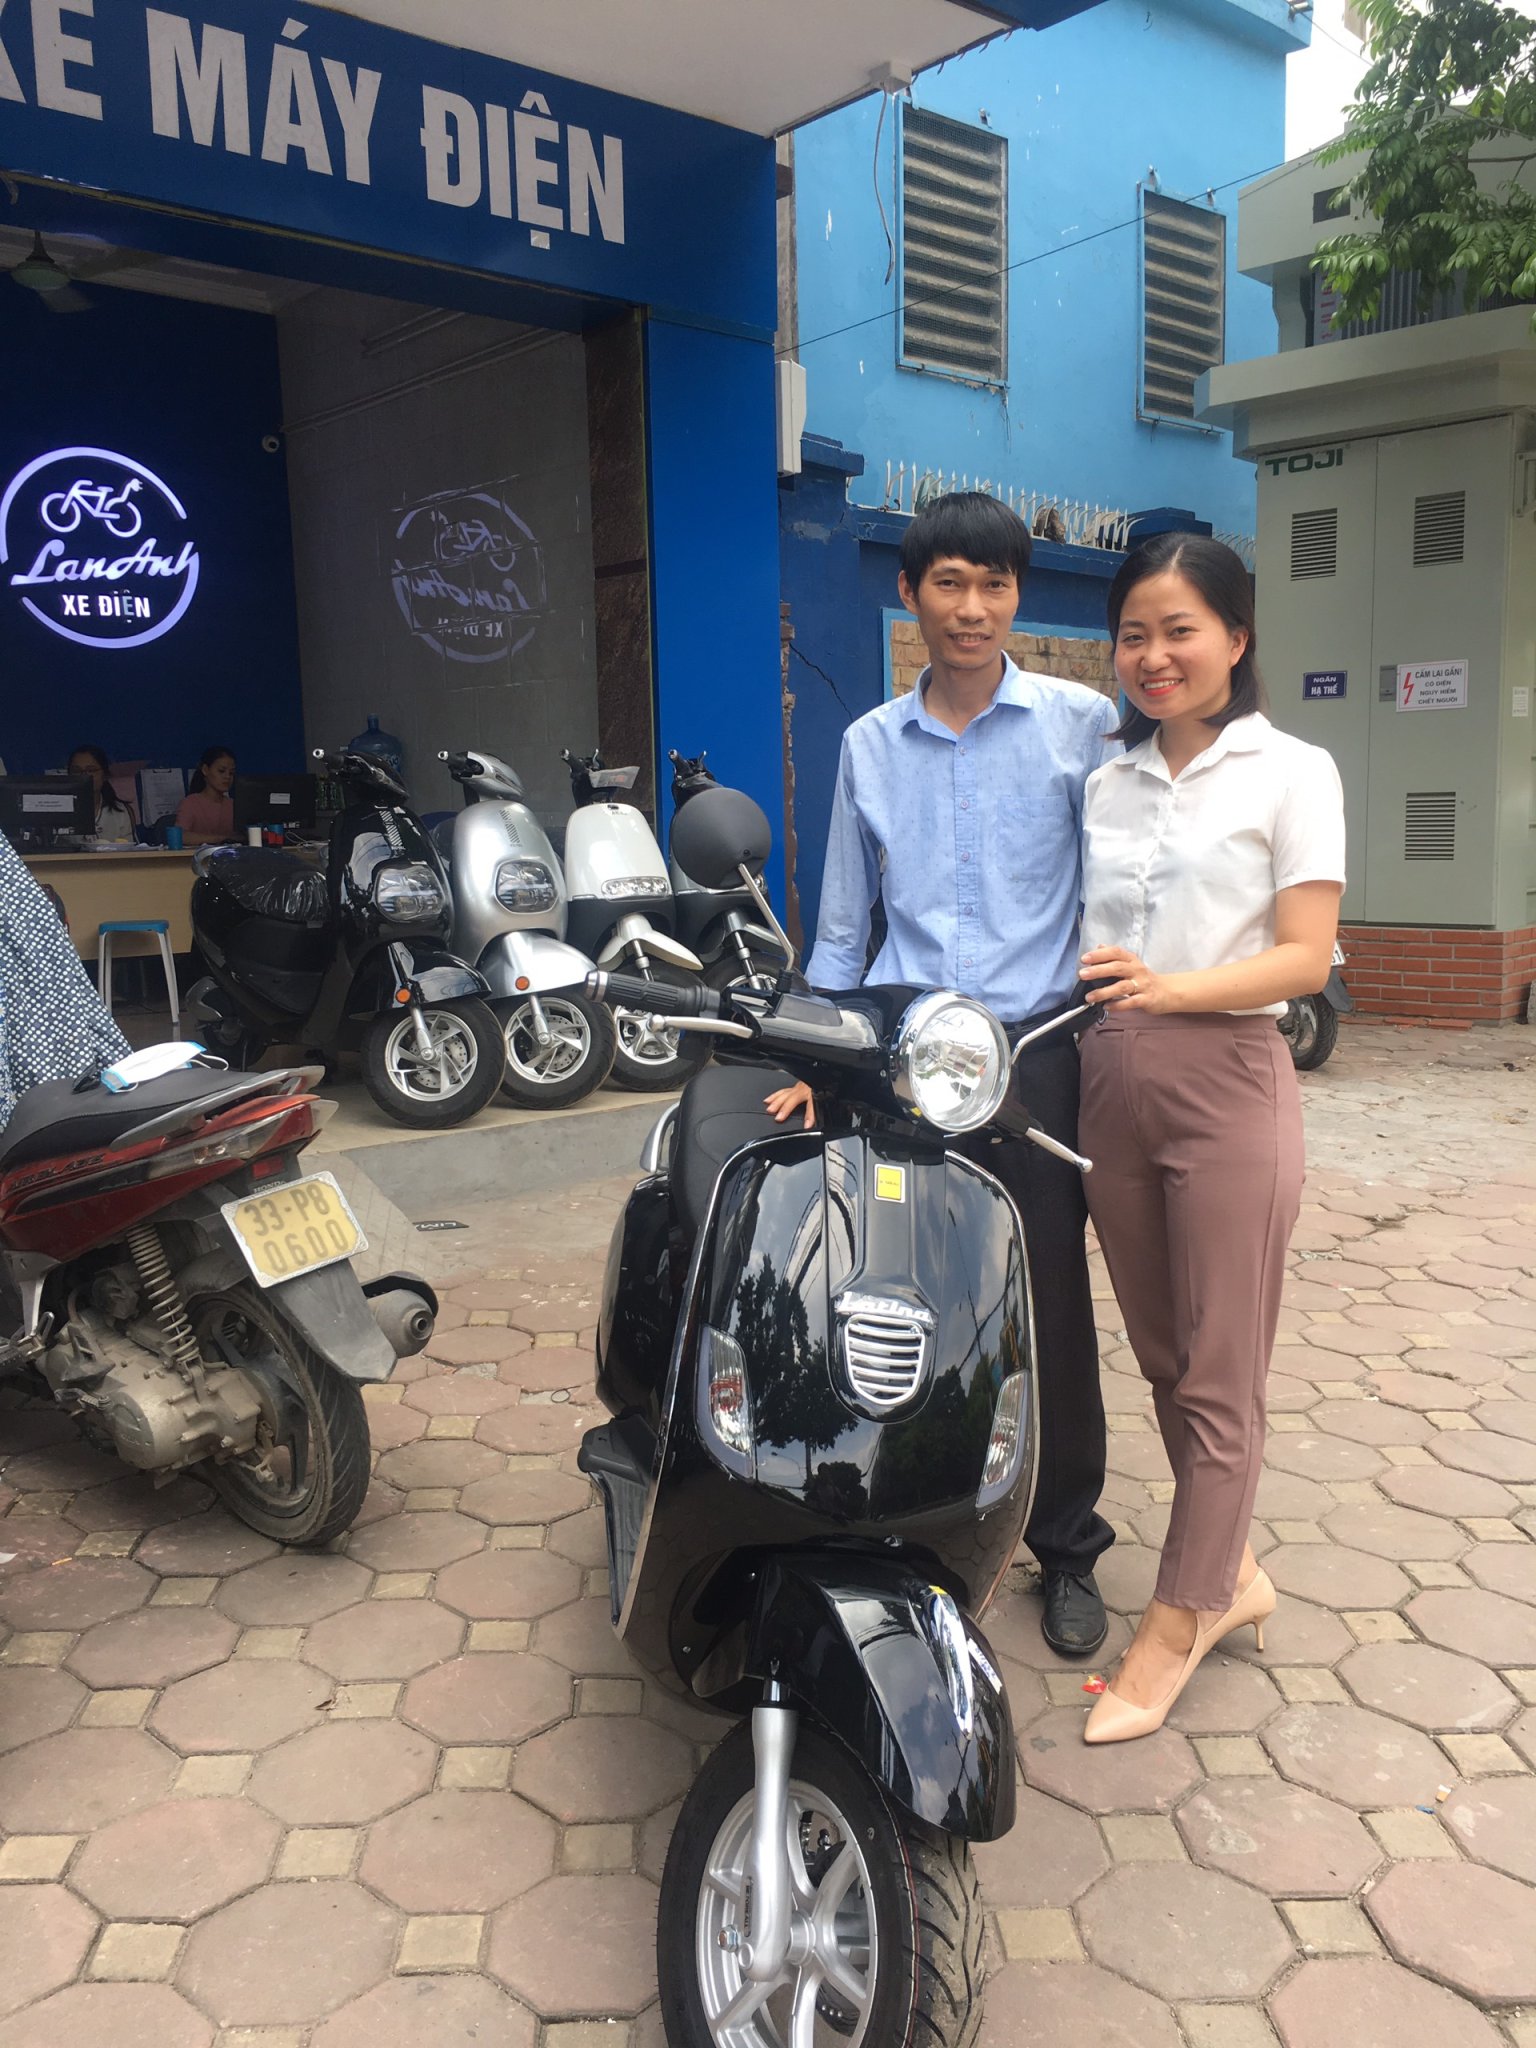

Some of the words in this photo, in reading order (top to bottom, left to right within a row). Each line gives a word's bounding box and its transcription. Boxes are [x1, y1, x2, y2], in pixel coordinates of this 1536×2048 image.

[145, 7, 382, 186] MÁY
[420, 84, 625, 250] ĐIỆN
[1265, 448, 1343, 476] TOJI
[62, 594, 91, 617] XE
[244, 1183, 331, 1237] 33-P8
[263, 1219, 350, 1274] 0600
